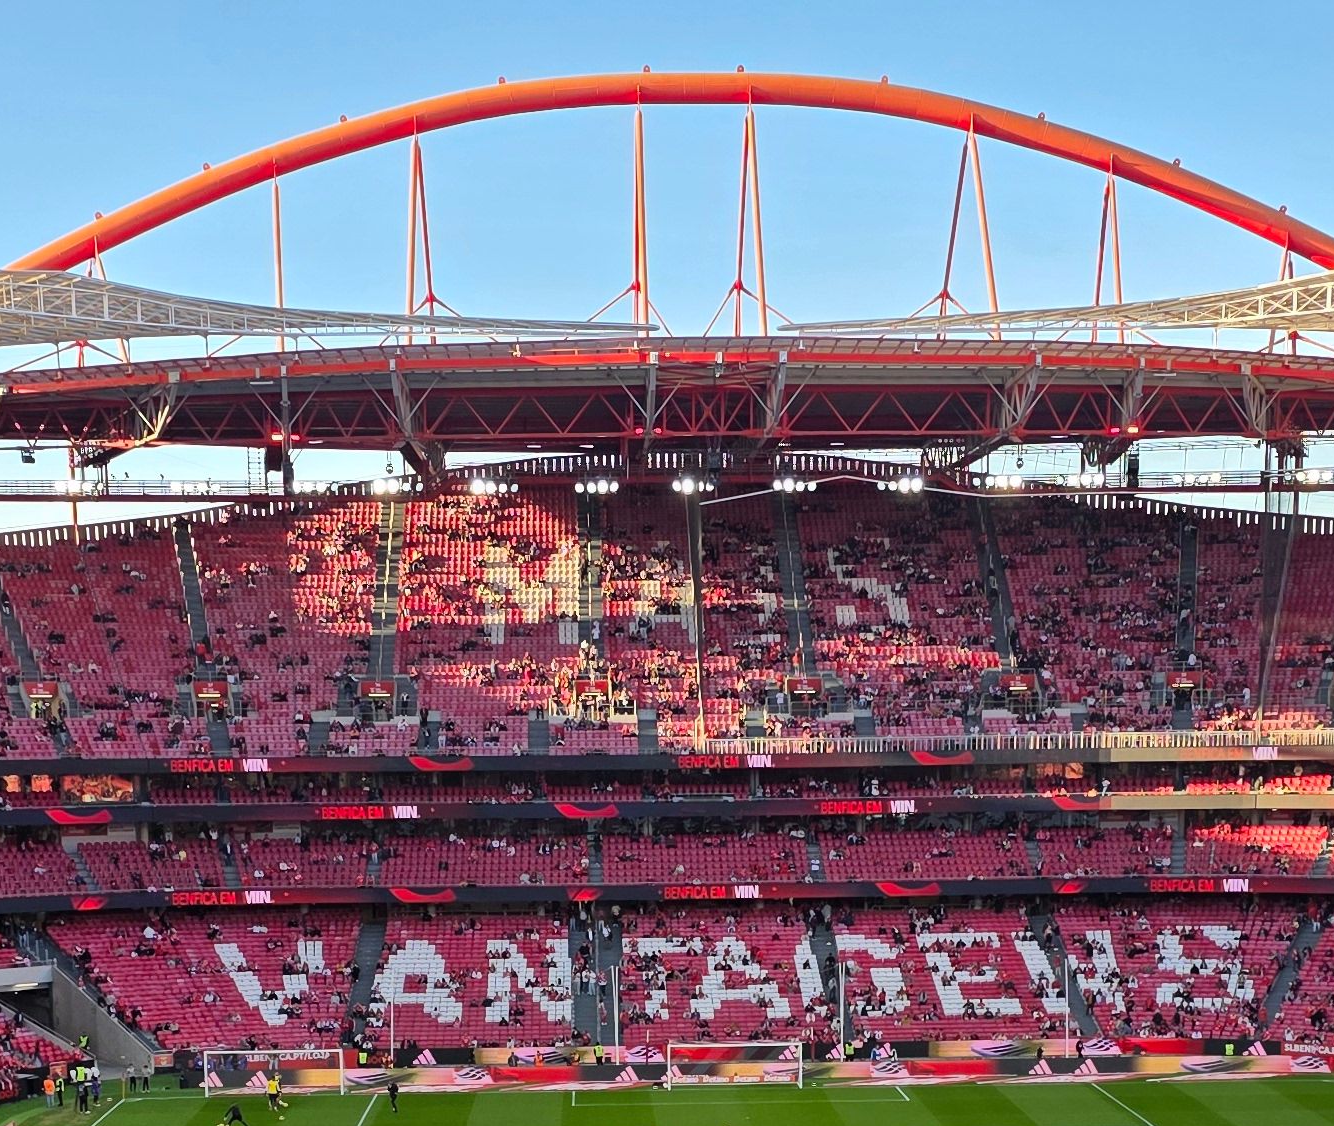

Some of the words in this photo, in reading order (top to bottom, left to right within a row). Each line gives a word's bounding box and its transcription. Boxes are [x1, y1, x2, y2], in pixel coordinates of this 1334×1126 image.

[170, 758, 216, 773] BENFICA
[678, 755, 721, 769] BENFICA
[321, 805, 366, 820] BENFICA
[820, 799, 866, 815] BENFICA
[665, 884, 709, 900] BENFICA
[1150, 878, 1196, 893] BENFICA
[172, 890, 218, 906] BENFICA
